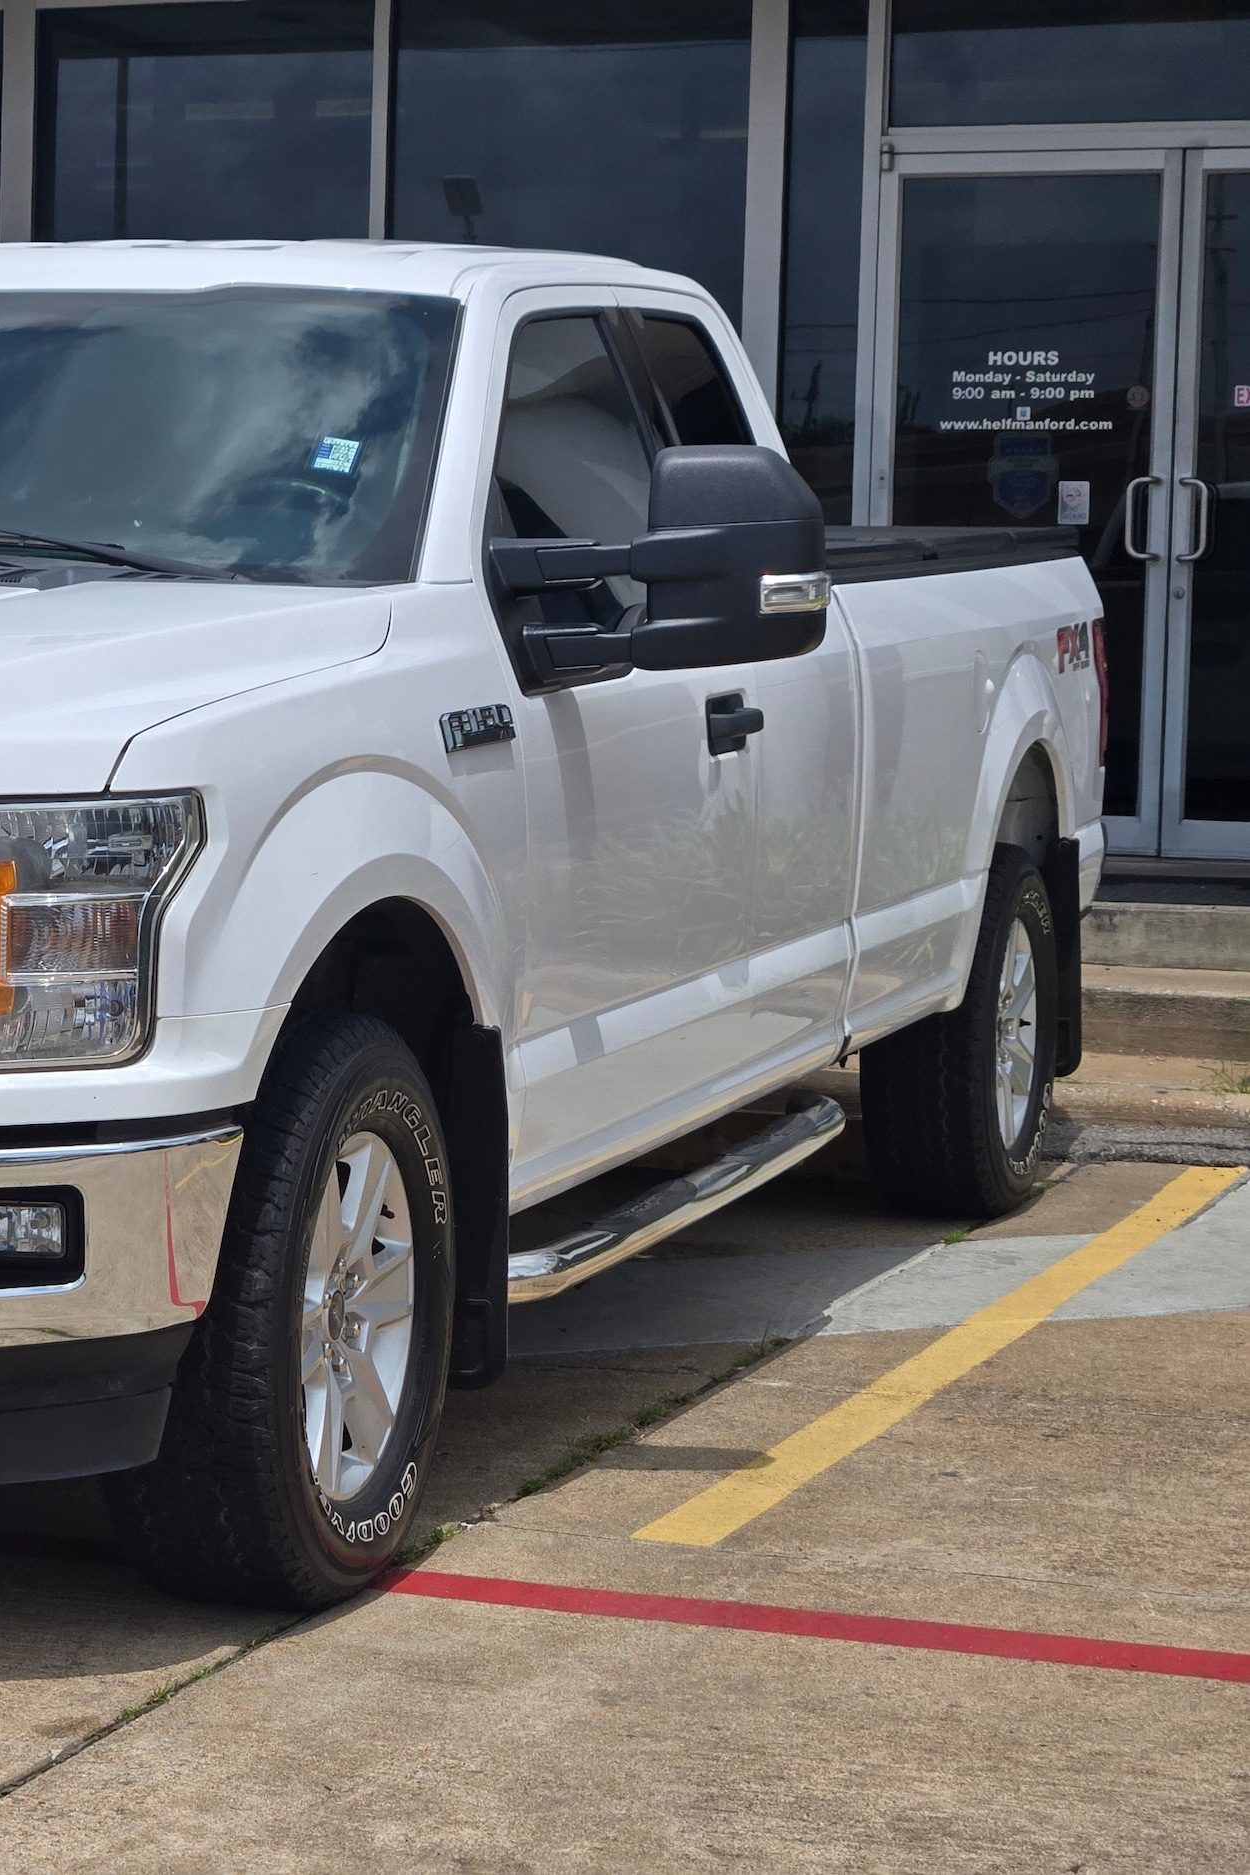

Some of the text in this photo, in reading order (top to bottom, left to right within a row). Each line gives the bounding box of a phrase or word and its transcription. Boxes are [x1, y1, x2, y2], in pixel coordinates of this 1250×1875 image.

[988, 351, 1059, 366] HOURS
[952, 370, 1012, 385] Monday
[1025, 370, 1095, 385] Saturday
[952, 386, 985, 400] 9:00
[990, 389, 1016, 399] am
[1030, 387, 1065, 399] 9:00
[1069, 389, 1095, 401] pm
[939, 418, 1113, 430] www.helfmanford.com
[1057, 621, 1090, 674] FX4
[310, 1462, 417, 1543] GOODYE
